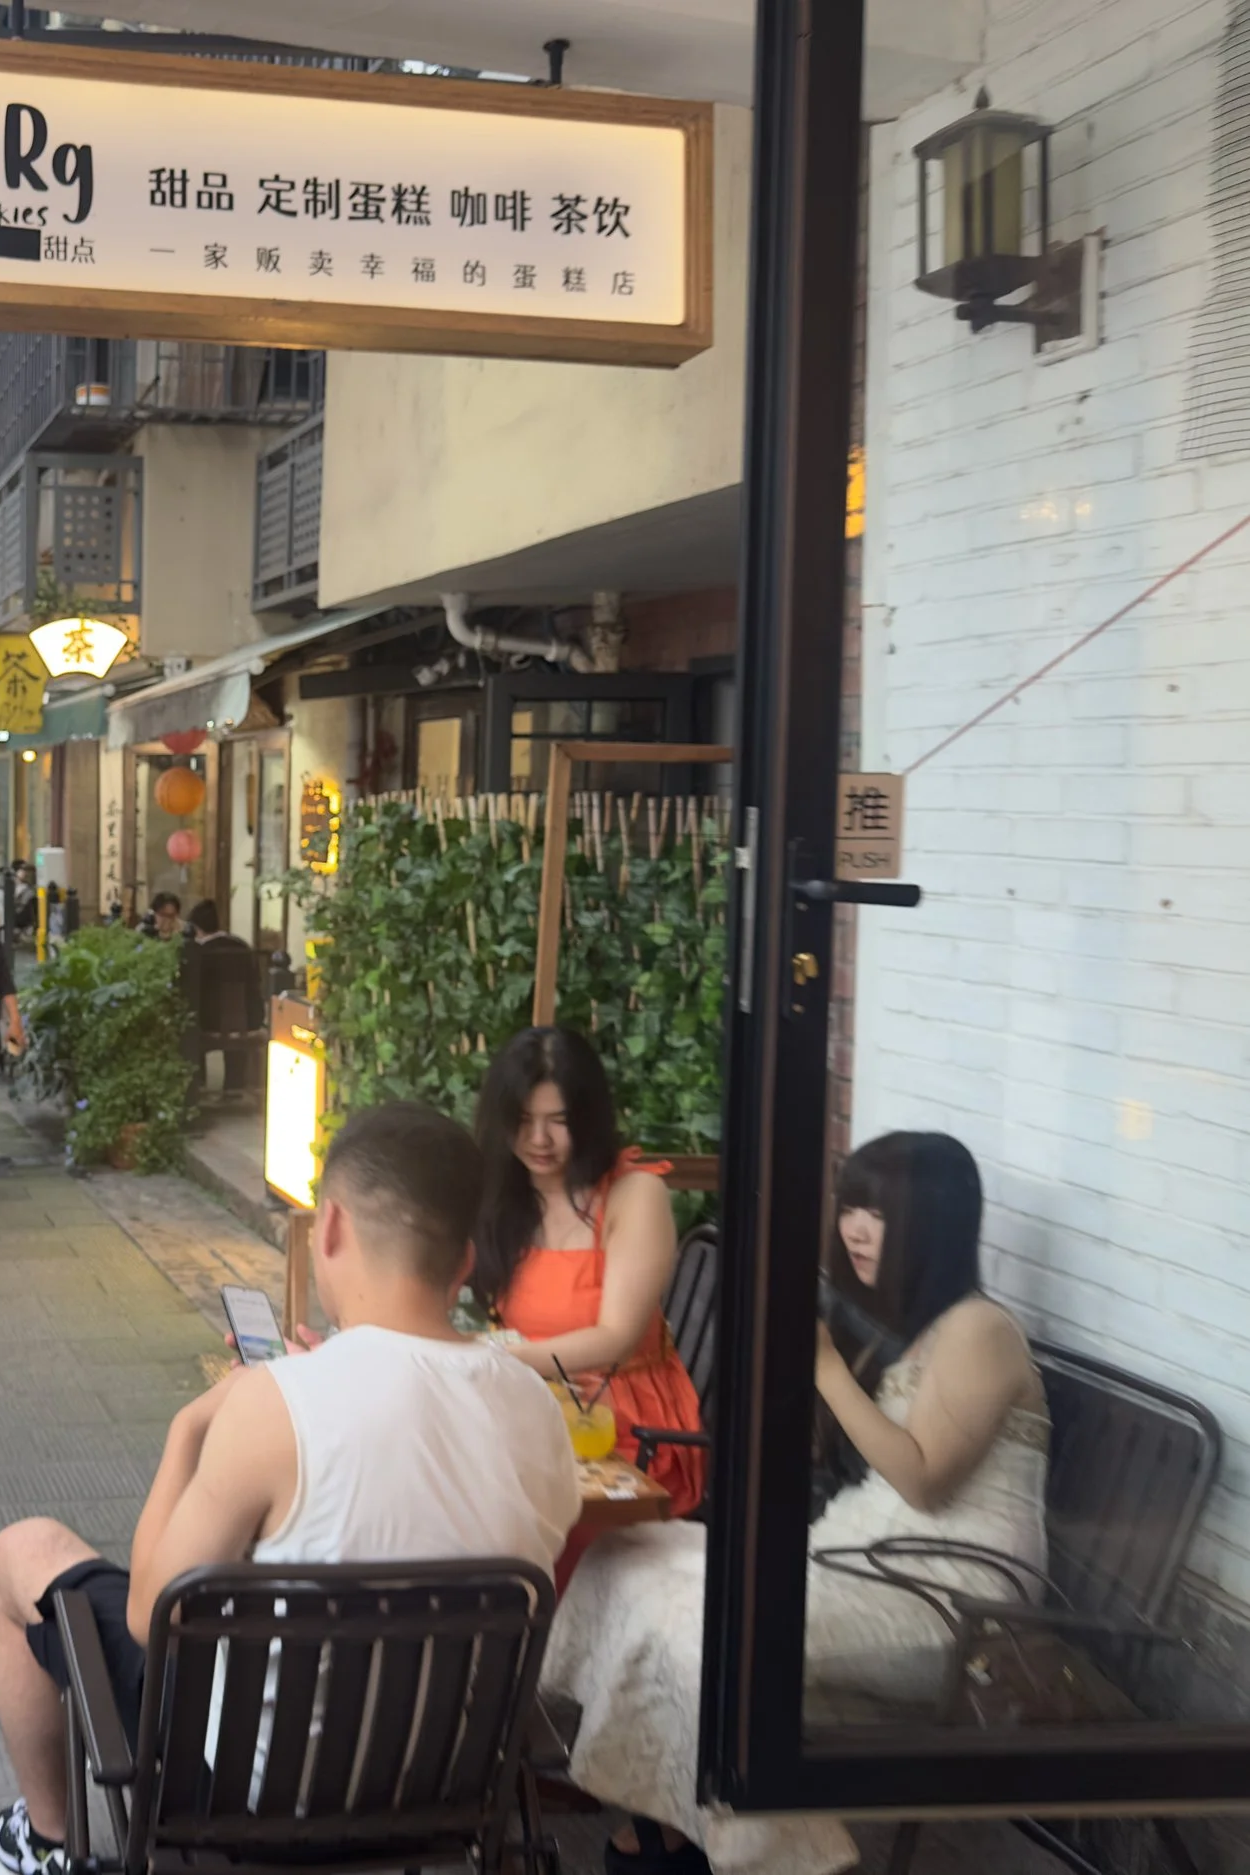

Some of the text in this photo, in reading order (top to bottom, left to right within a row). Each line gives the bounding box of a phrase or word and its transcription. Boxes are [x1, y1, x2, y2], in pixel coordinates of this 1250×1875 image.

[4, 102, 94, 225] Rg
[148, 167, 632, 239] 甜品 定制蛋糕 咖啡 茶饮
[44, 235, 96, 264] 甜点
[62, 620, 95, 664] 茶
[843, 786, 890, 831] 推
[837, 851, 892, 869] PUSH
